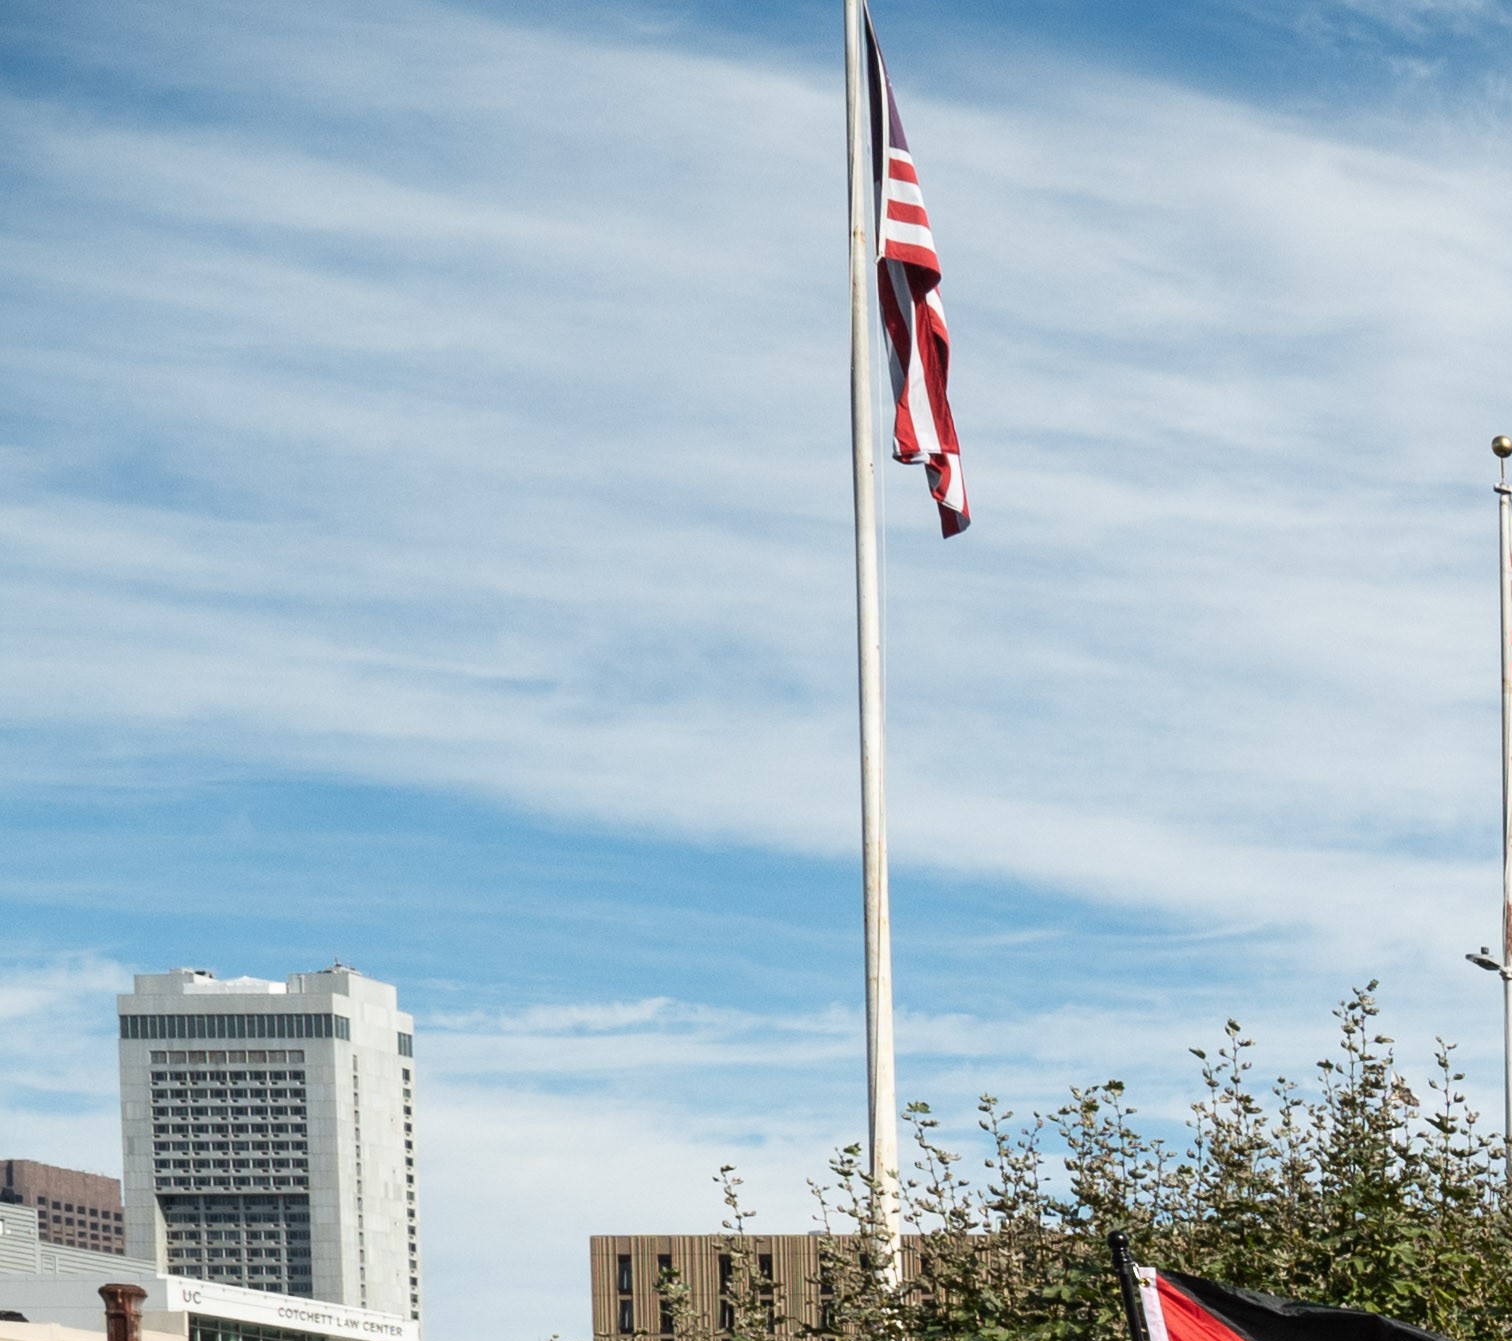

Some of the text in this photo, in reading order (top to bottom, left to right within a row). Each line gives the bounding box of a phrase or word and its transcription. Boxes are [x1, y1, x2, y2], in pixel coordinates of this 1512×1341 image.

[182, 1290, 402, 1336] UC COTCHETT LAW CENTER
